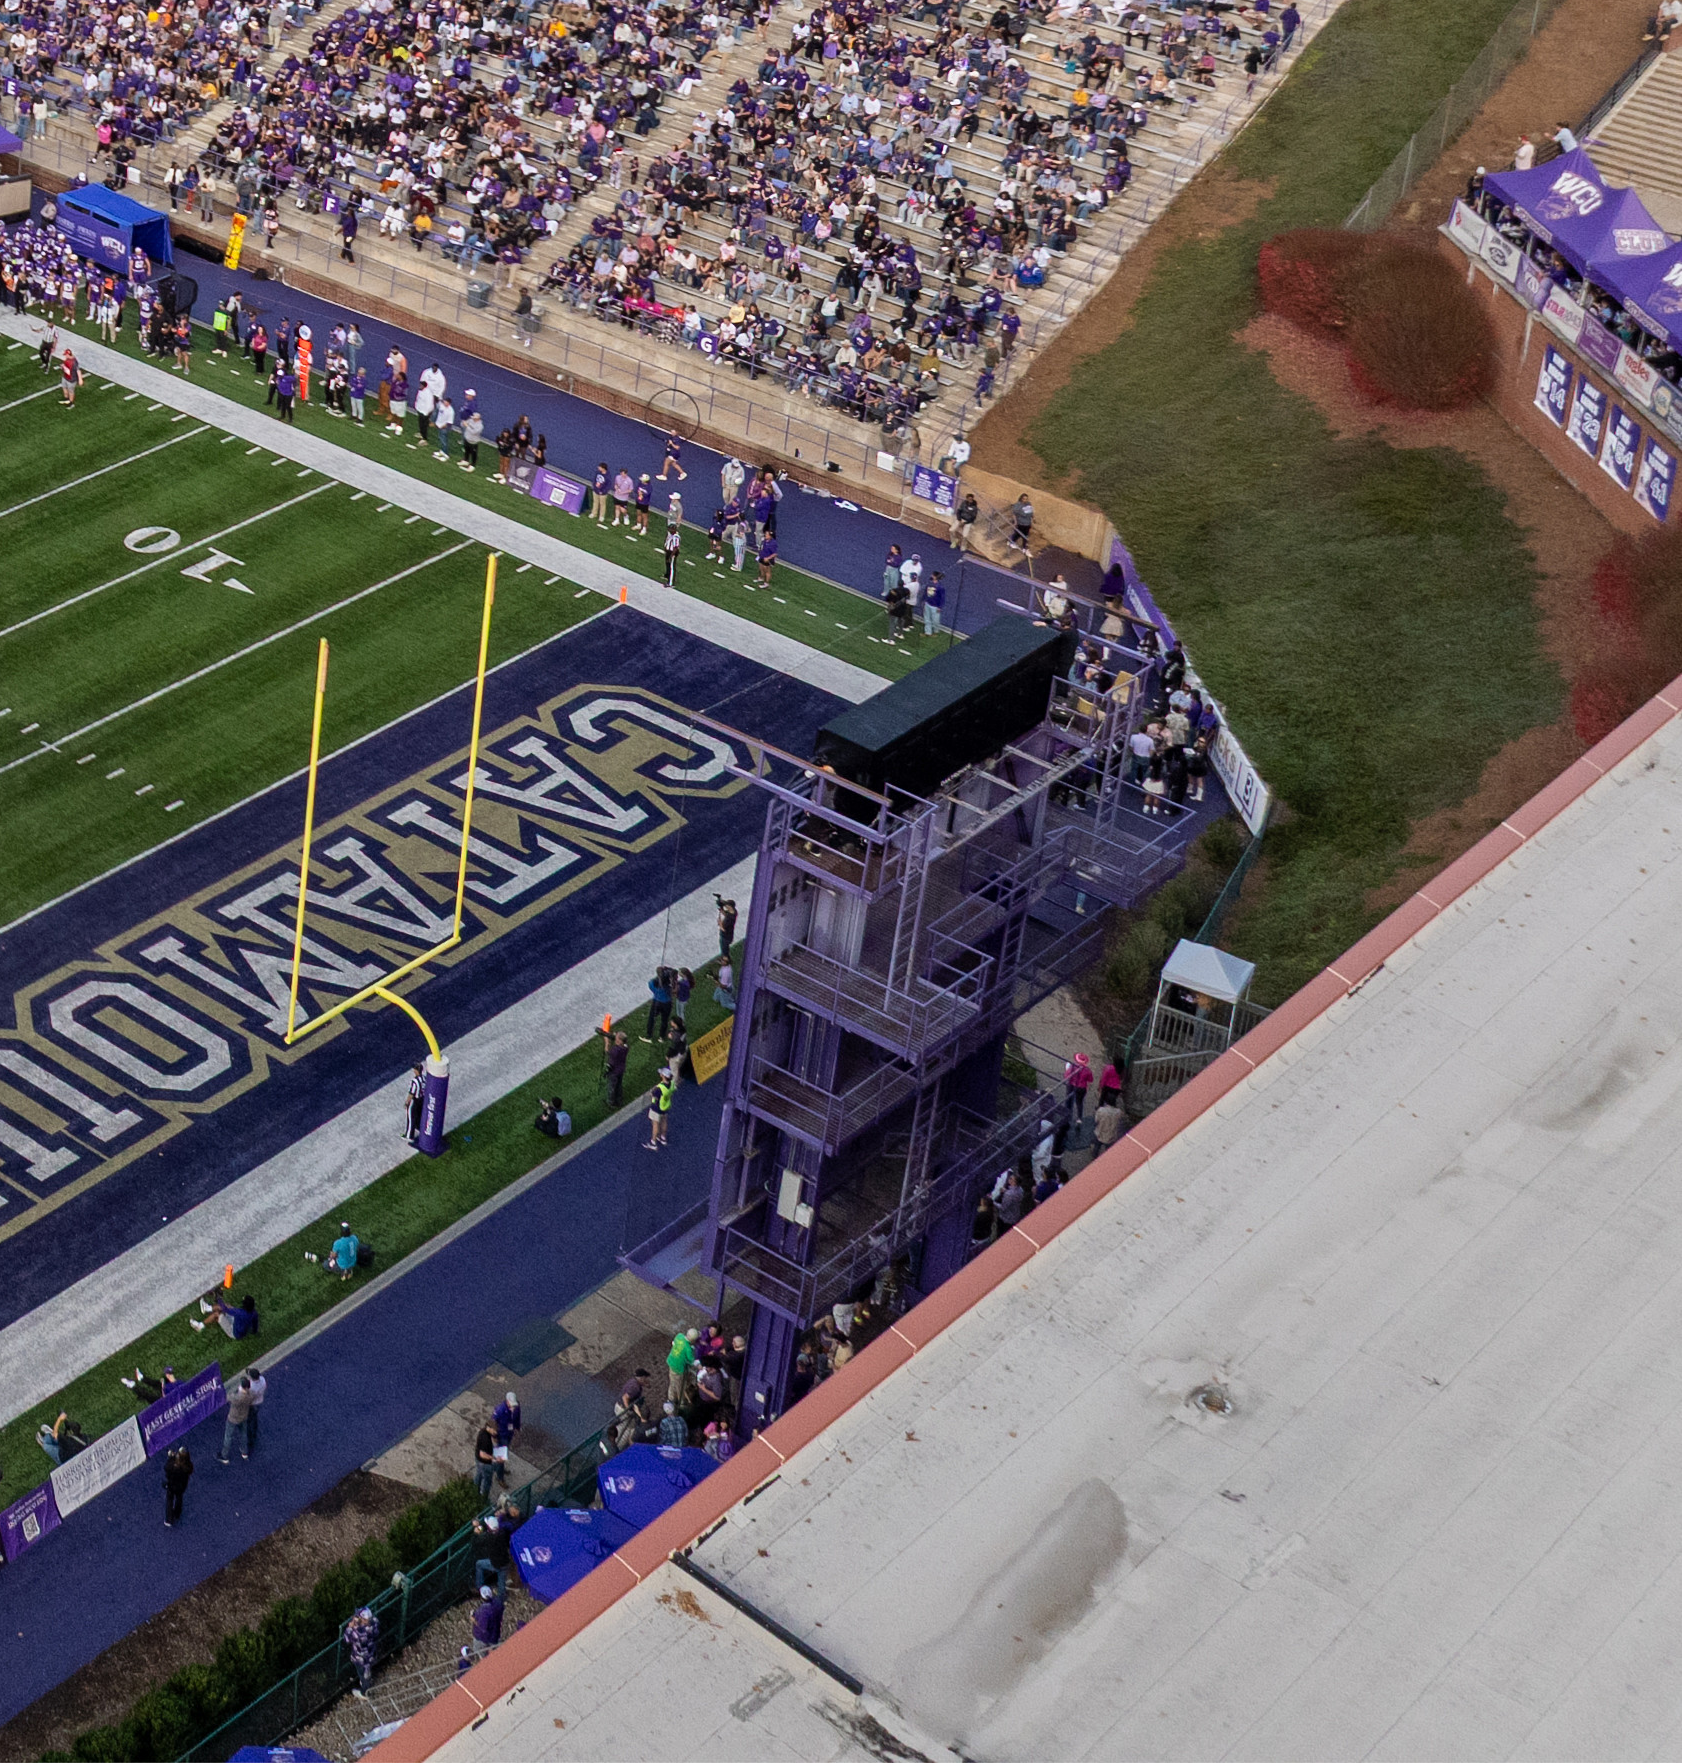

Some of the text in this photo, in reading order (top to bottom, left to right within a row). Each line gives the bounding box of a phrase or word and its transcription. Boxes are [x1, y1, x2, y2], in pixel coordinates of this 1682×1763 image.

[7, 80, 17, 96] E
[325, 196, 336, 212] F
[1552, 171, 1603, 216] WCU
[100, 235, 126, 254] WCU
[700, 336, 713, 353] G
[1624, 348, 1651, 384] ingles
[123, 525, 247, 584] 10
[1242, 770, 1254, 806] 3
[163, 1394, 195, 1420] GENERAL
[194, 1377, 220, 1399] STORE
